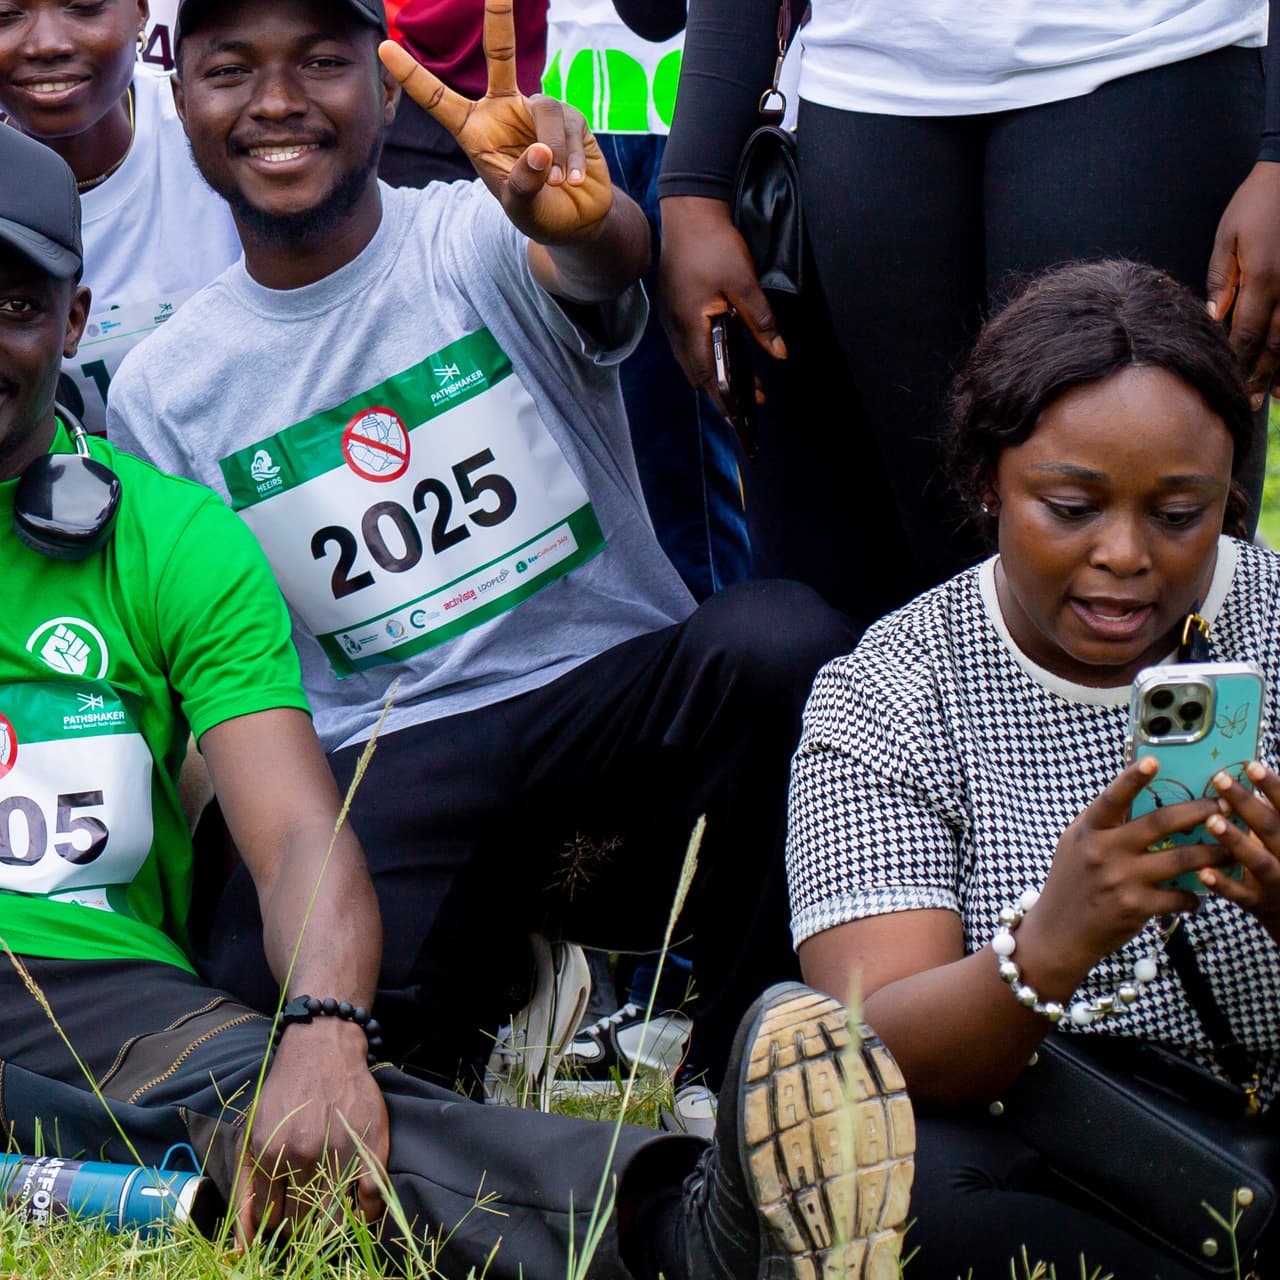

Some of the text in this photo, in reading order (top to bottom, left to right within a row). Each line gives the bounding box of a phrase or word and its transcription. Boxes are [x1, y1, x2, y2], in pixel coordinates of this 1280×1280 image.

[430, 370, 484, 402] PATHSHAKER
[256, 476, 284, 495] HEEIRS
[310, 447, 517, 600] 2025
[477, 574, 506, 593] LOOPED
[63, 711, 125, 725] PATHSHAKER
